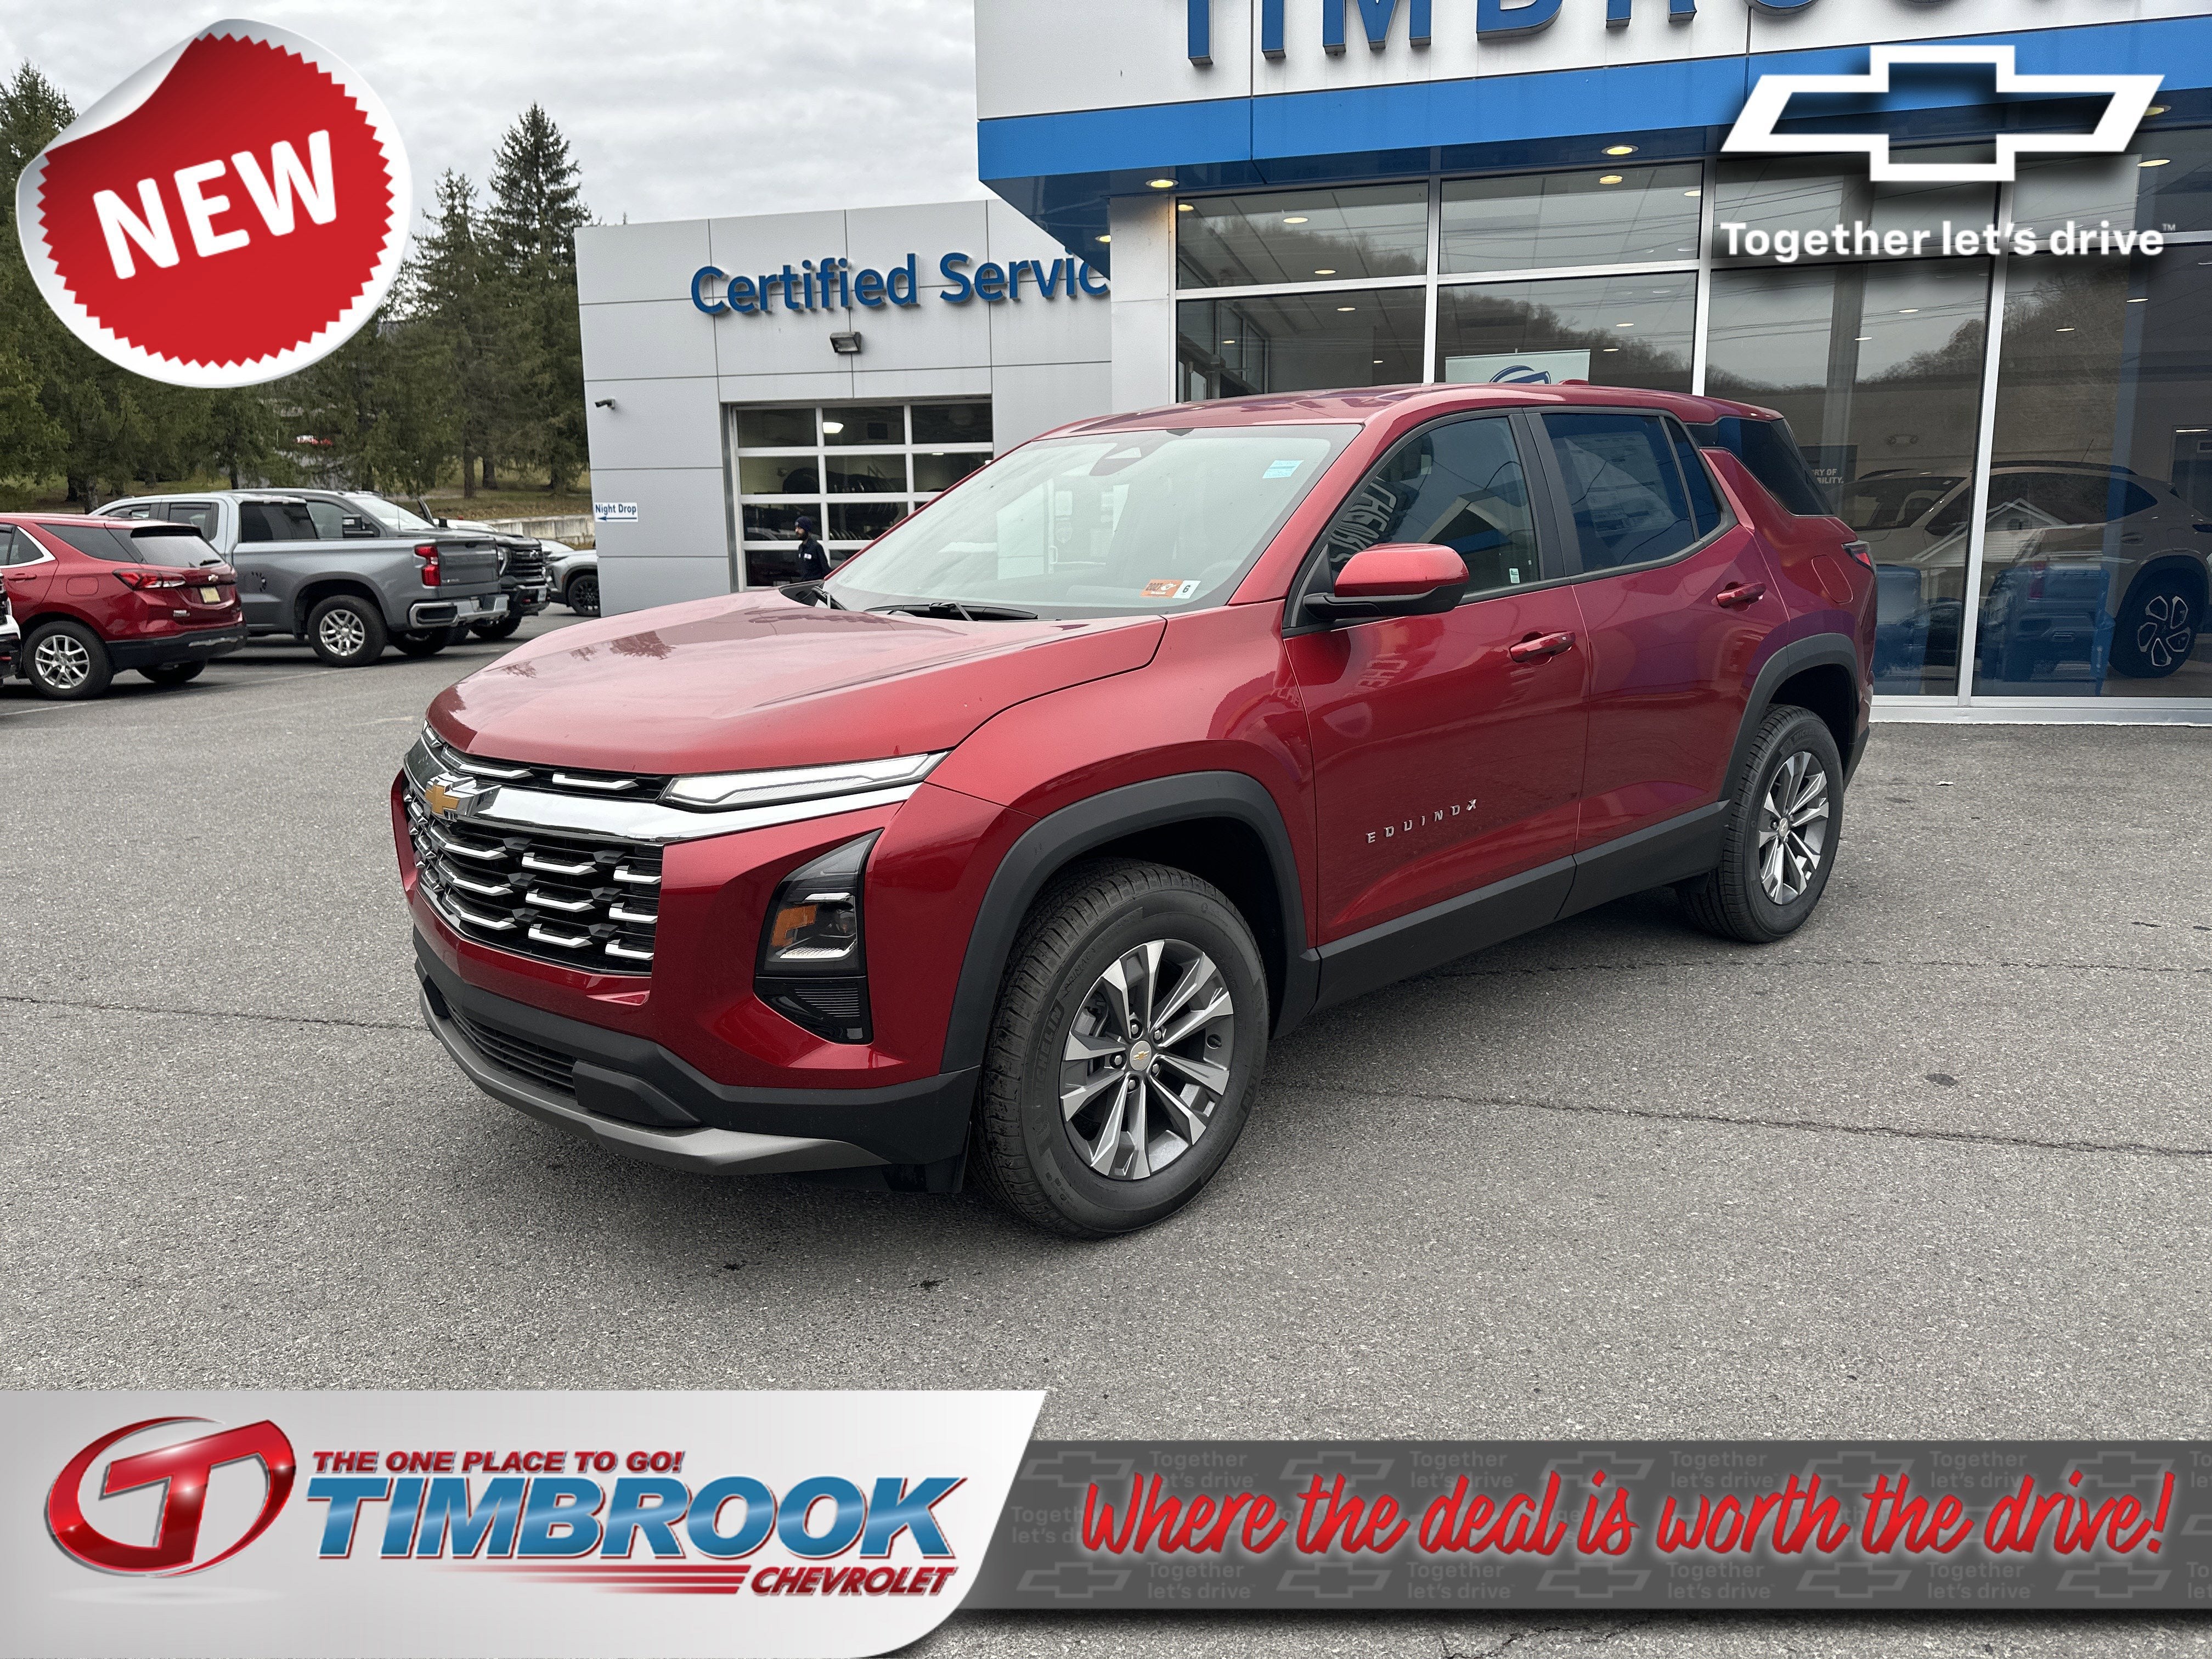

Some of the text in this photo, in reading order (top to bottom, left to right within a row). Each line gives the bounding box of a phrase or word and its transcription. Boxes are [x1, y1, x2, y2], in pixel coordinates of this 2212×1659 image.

[691, 246, 1110, 315] Certified Servic
[595, 504, 636, 515] Night Drop
[1182, 585, 1191, 593] 6
[1366, 799, 1477, 844] EQUINOX
